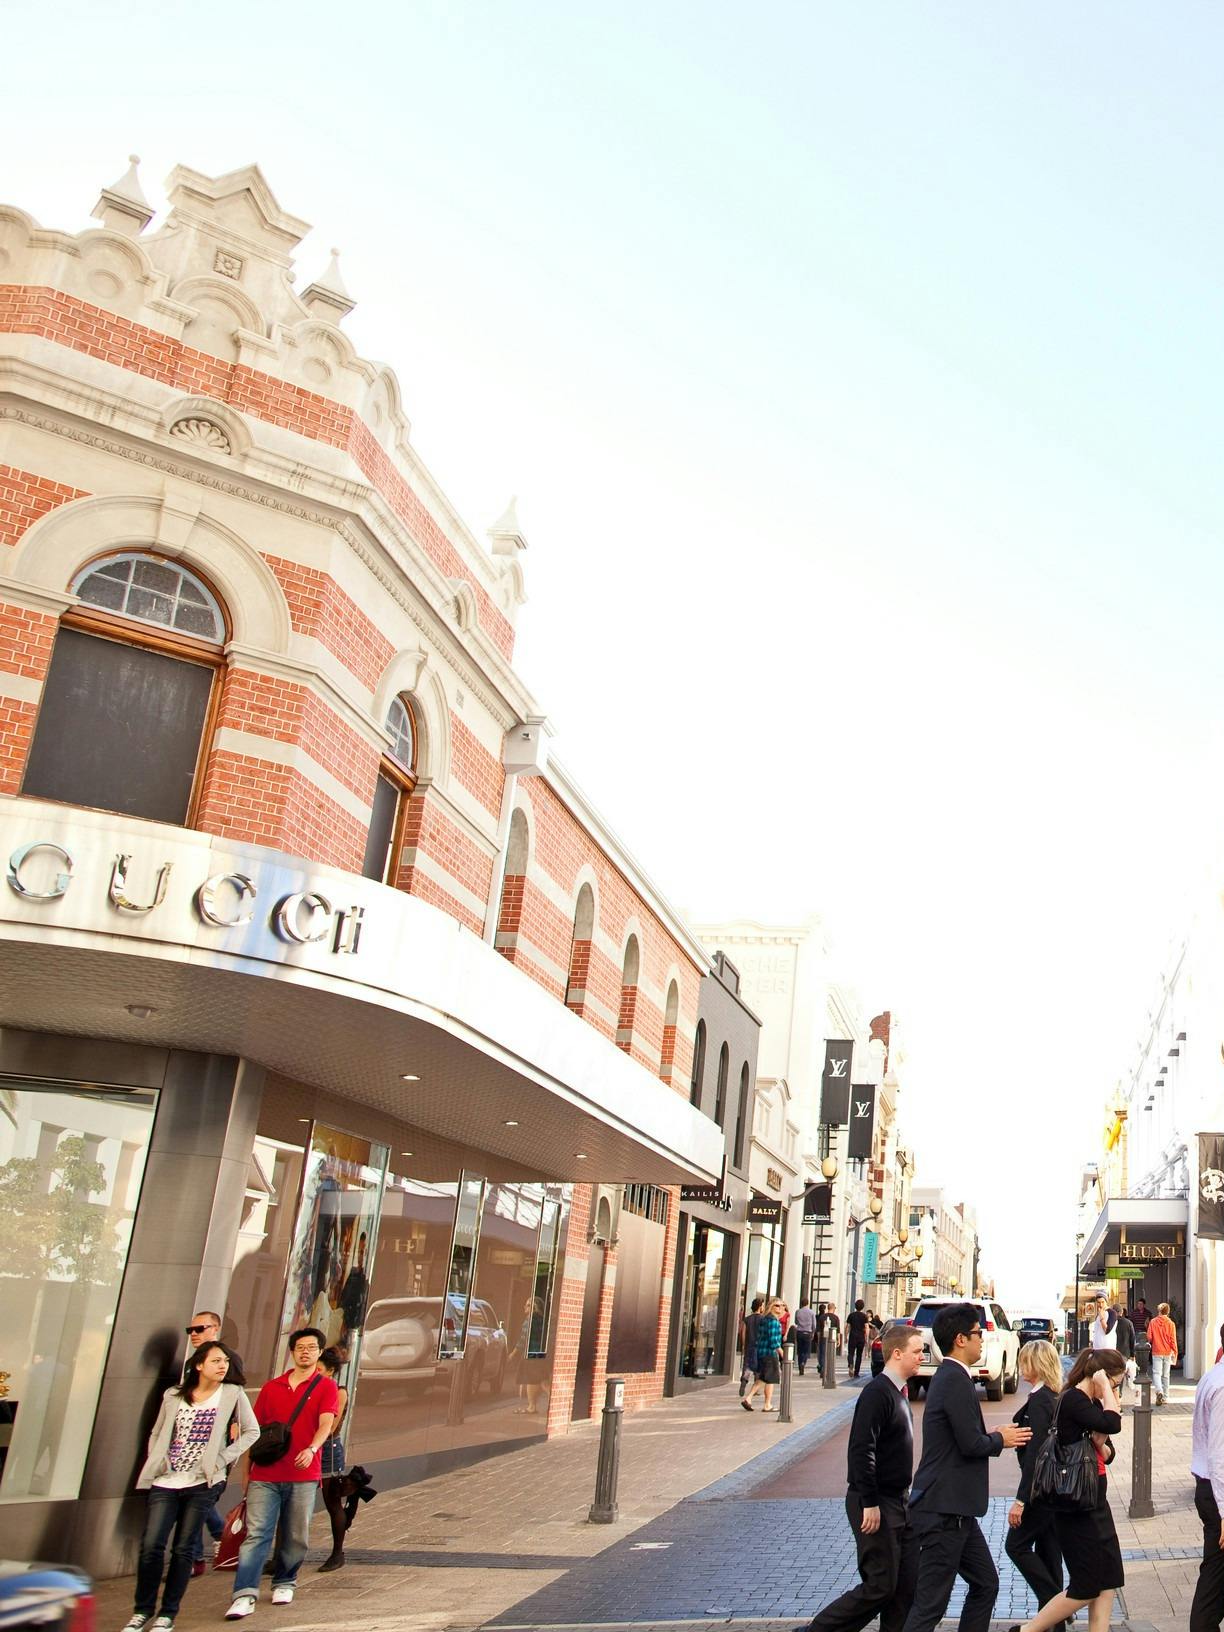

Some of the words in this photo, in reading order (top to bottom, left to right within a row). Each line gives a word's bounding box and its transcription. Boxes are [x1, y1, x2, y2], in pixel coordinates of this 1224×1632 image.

[6, 840, 366, 954] GUCCI
[752, 1207, 778, 1216] BALLY
[1124, 1244, 1177, 1258] HUNT
